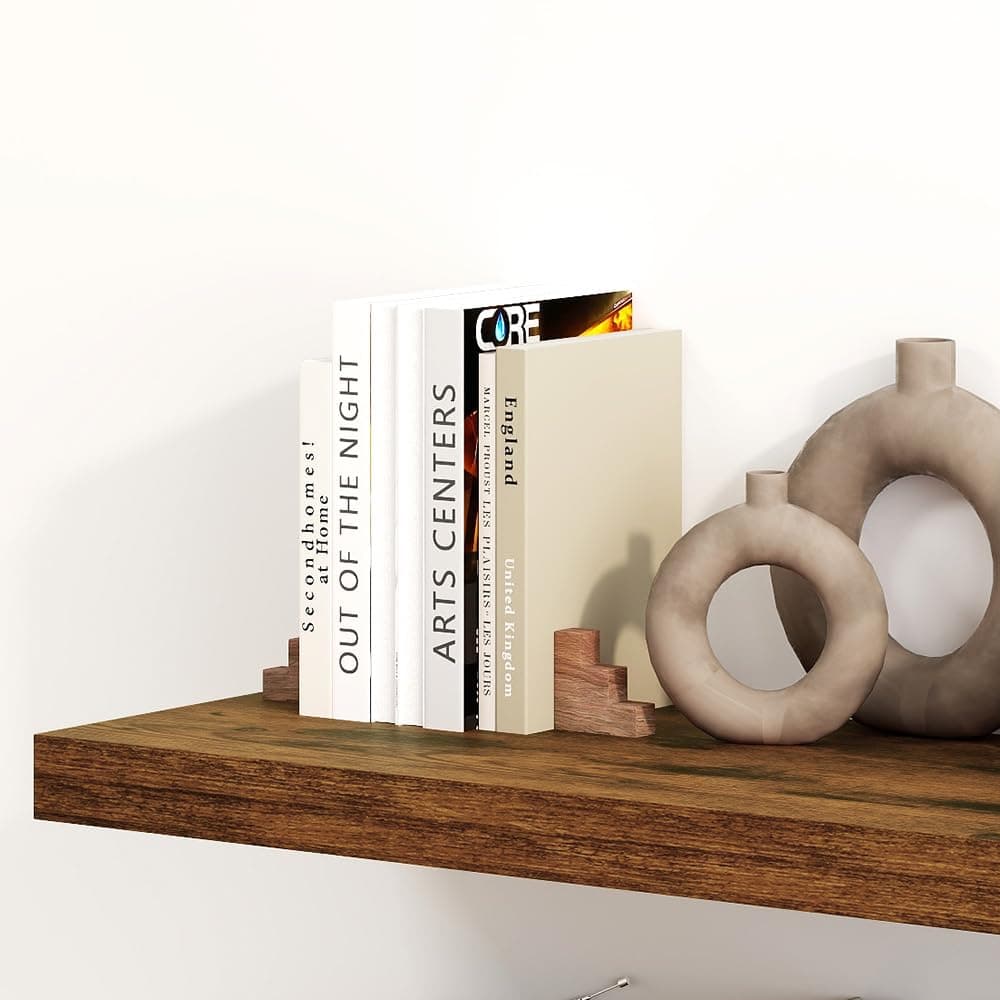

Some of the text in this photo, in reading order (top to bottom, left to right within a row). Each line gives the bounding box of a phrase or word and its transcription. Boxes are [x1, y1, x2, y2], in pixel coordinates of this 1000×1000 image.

[482, 387, 491, 438] MARCEL
[338, 355, 359, 675] OUT OF THE NIGHT
[482, 445, 491, 495] PROUST
[482, 501, 491, 528] LES
[301, 441, 315, 633] Secondhomes!
[315, 495, 329, 585] at Home
[432, 384, 456, 664] ARTS CENTERS
[500, 397, 518, 697] England United Kingdom
[482, 651, 492, 696] JOURS
